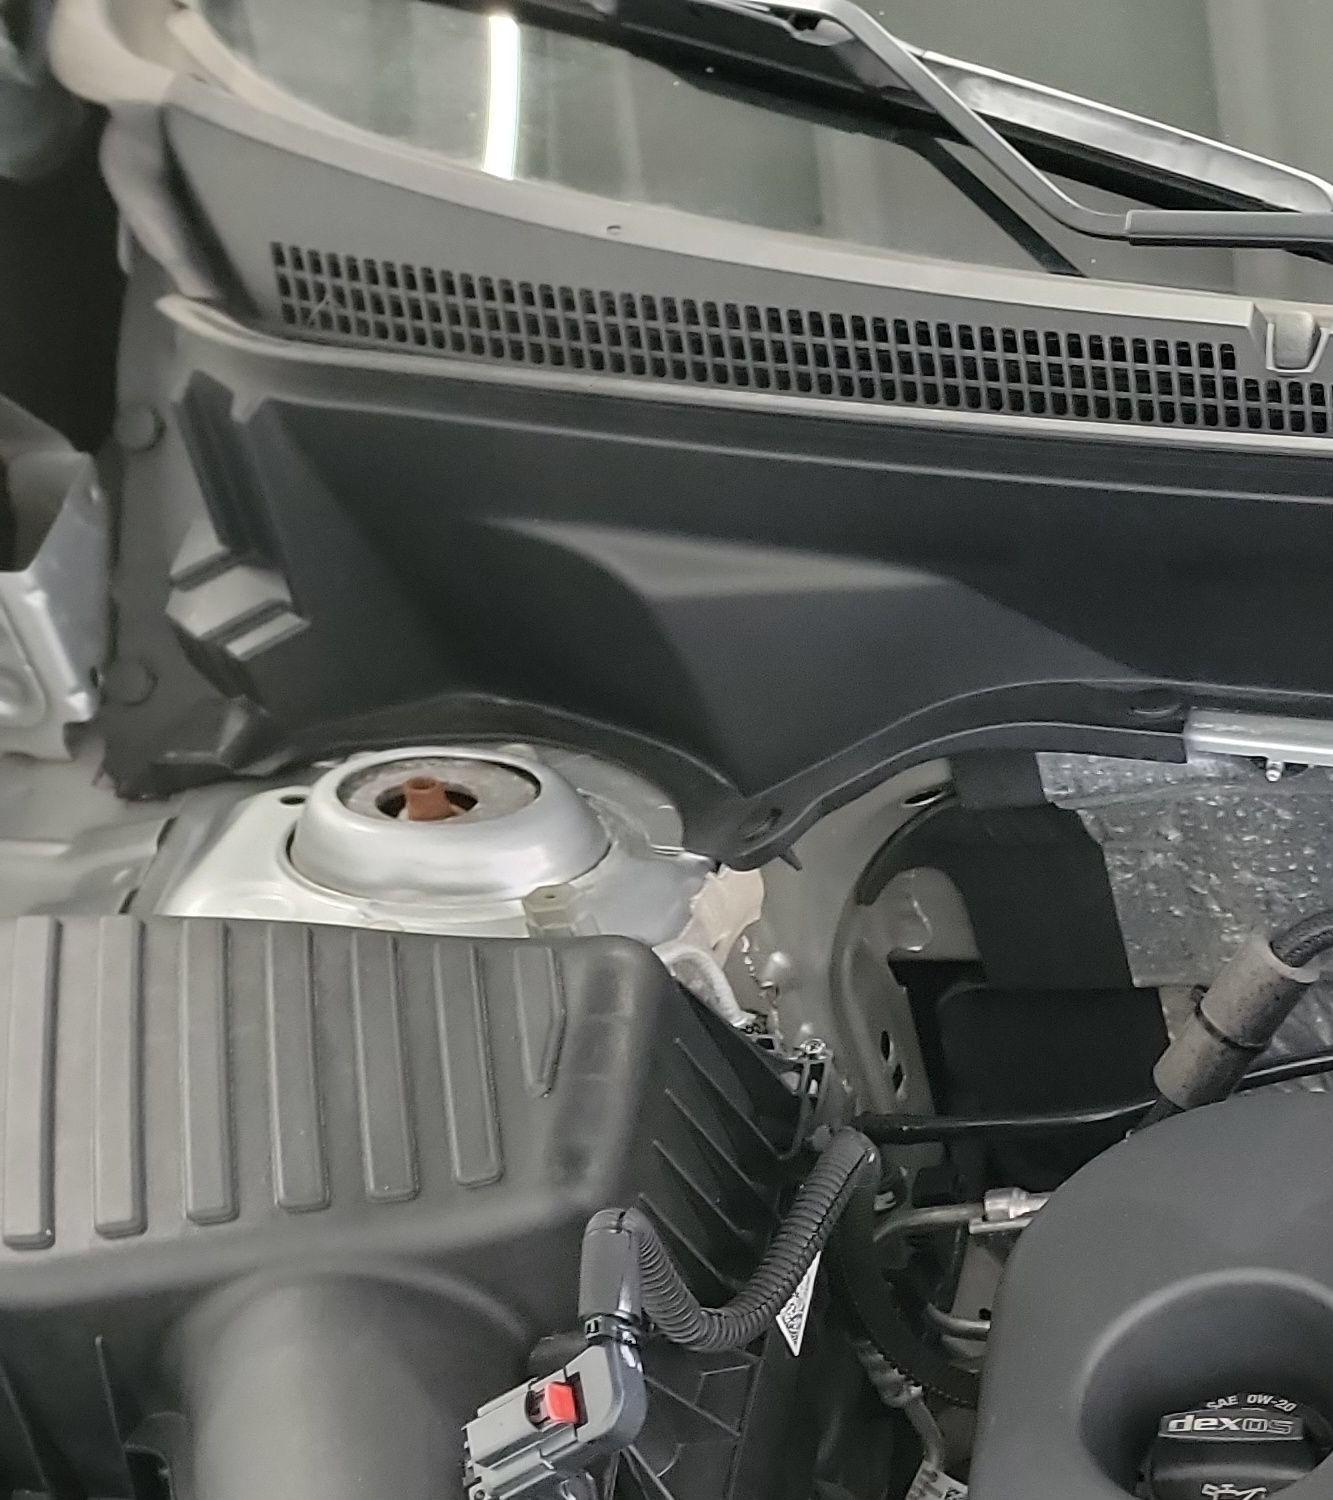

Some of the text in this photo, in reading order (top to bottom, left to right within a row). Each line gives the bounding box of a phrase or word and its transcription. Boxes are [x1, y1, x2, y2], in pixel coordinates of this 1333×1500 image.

[1206, 1393, 1297, 1413] SAE 0W-20
[1167, 1414, 1295, 1435] dexos
